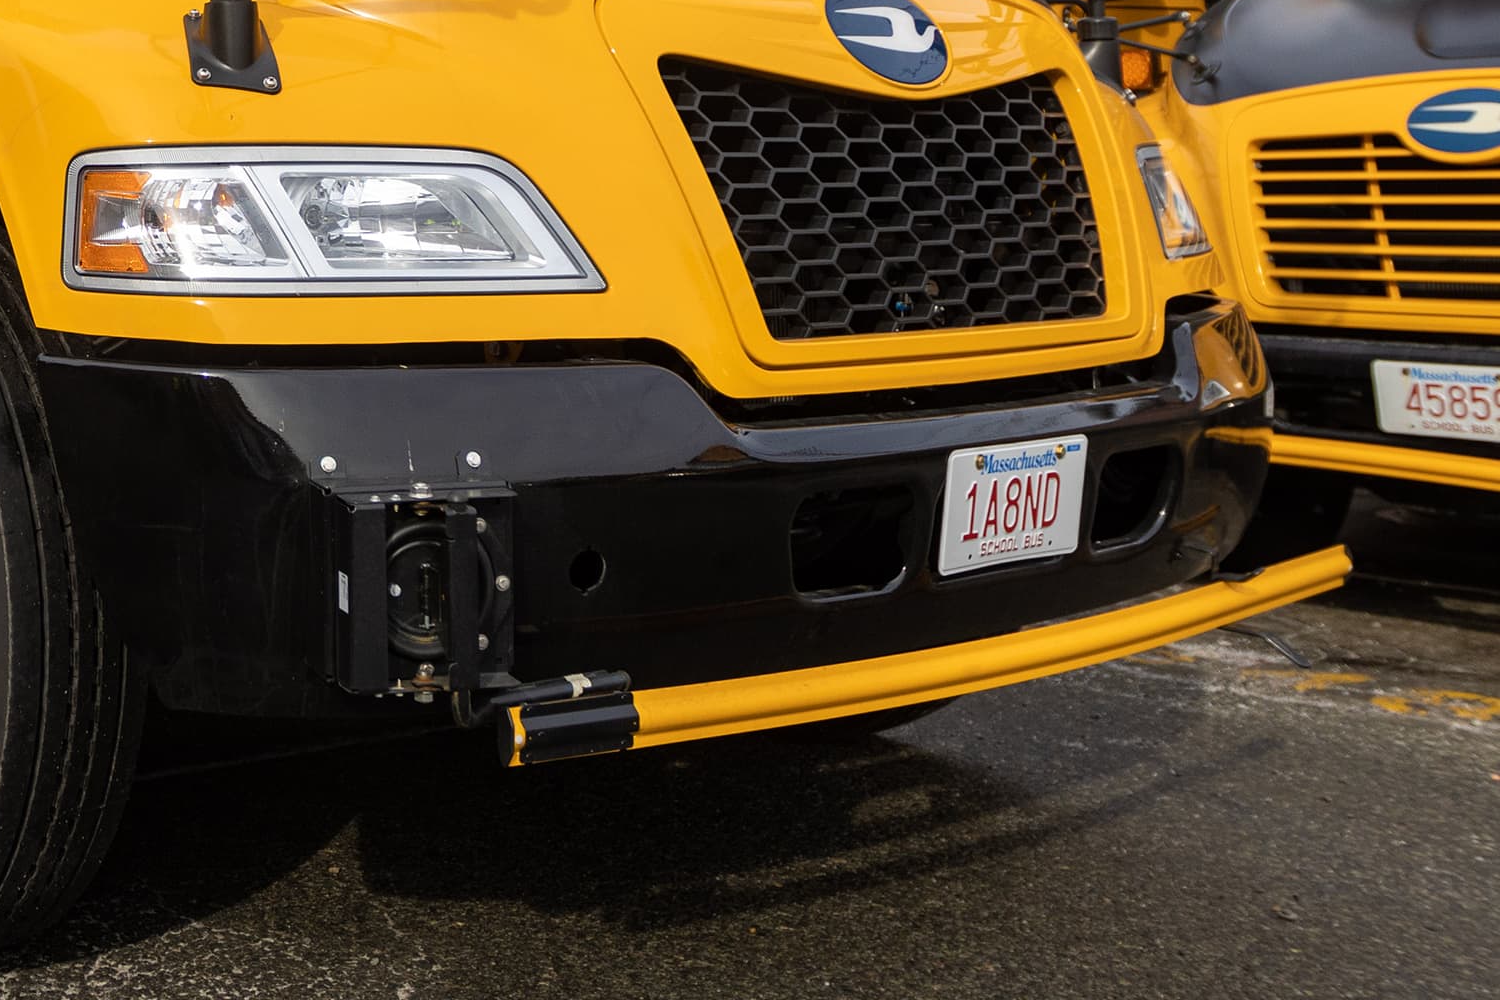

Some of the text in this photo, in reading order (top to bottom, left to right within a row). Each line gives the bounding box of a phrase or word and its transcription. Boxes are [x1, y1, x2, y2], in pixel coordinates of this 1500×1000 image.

[1422, 420, 1494, 434] SCHOOL BUS
[981, 450, 1057, 475] Massachusetts
[962, 471, 1061, 542] 1A8ND
[980, 533, 1044, 557] SCHOOL BUS
